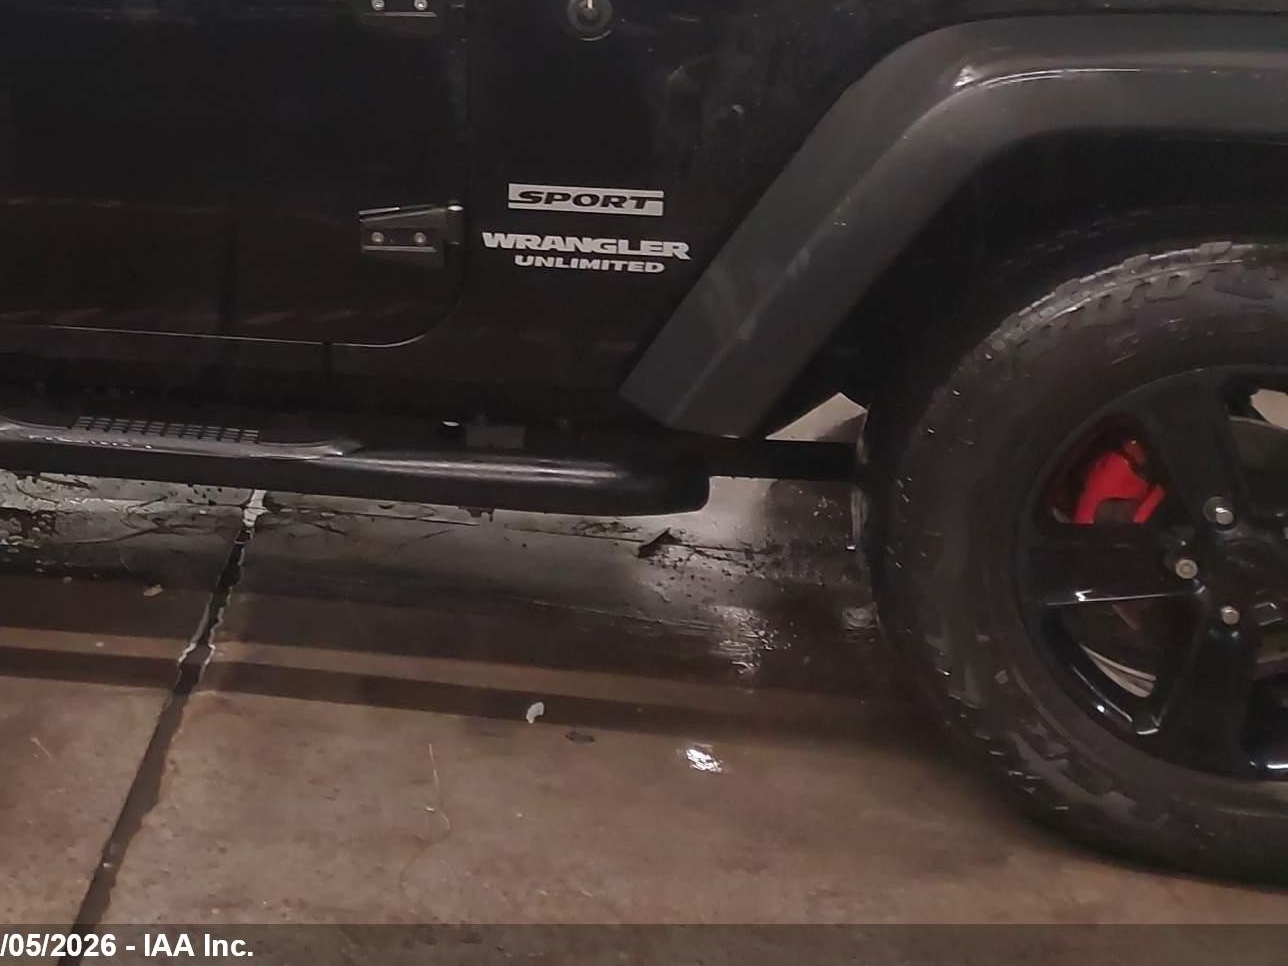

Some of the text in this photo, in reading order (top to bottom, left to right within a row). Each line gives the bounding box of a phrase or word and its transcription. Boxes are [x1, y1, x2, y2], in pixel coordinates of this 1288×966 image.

[517, 190, 652, 210] SPORT
[482, 232, 691, 260] WRANGLER
[514, 255, 665, 273] UNLIMITED
